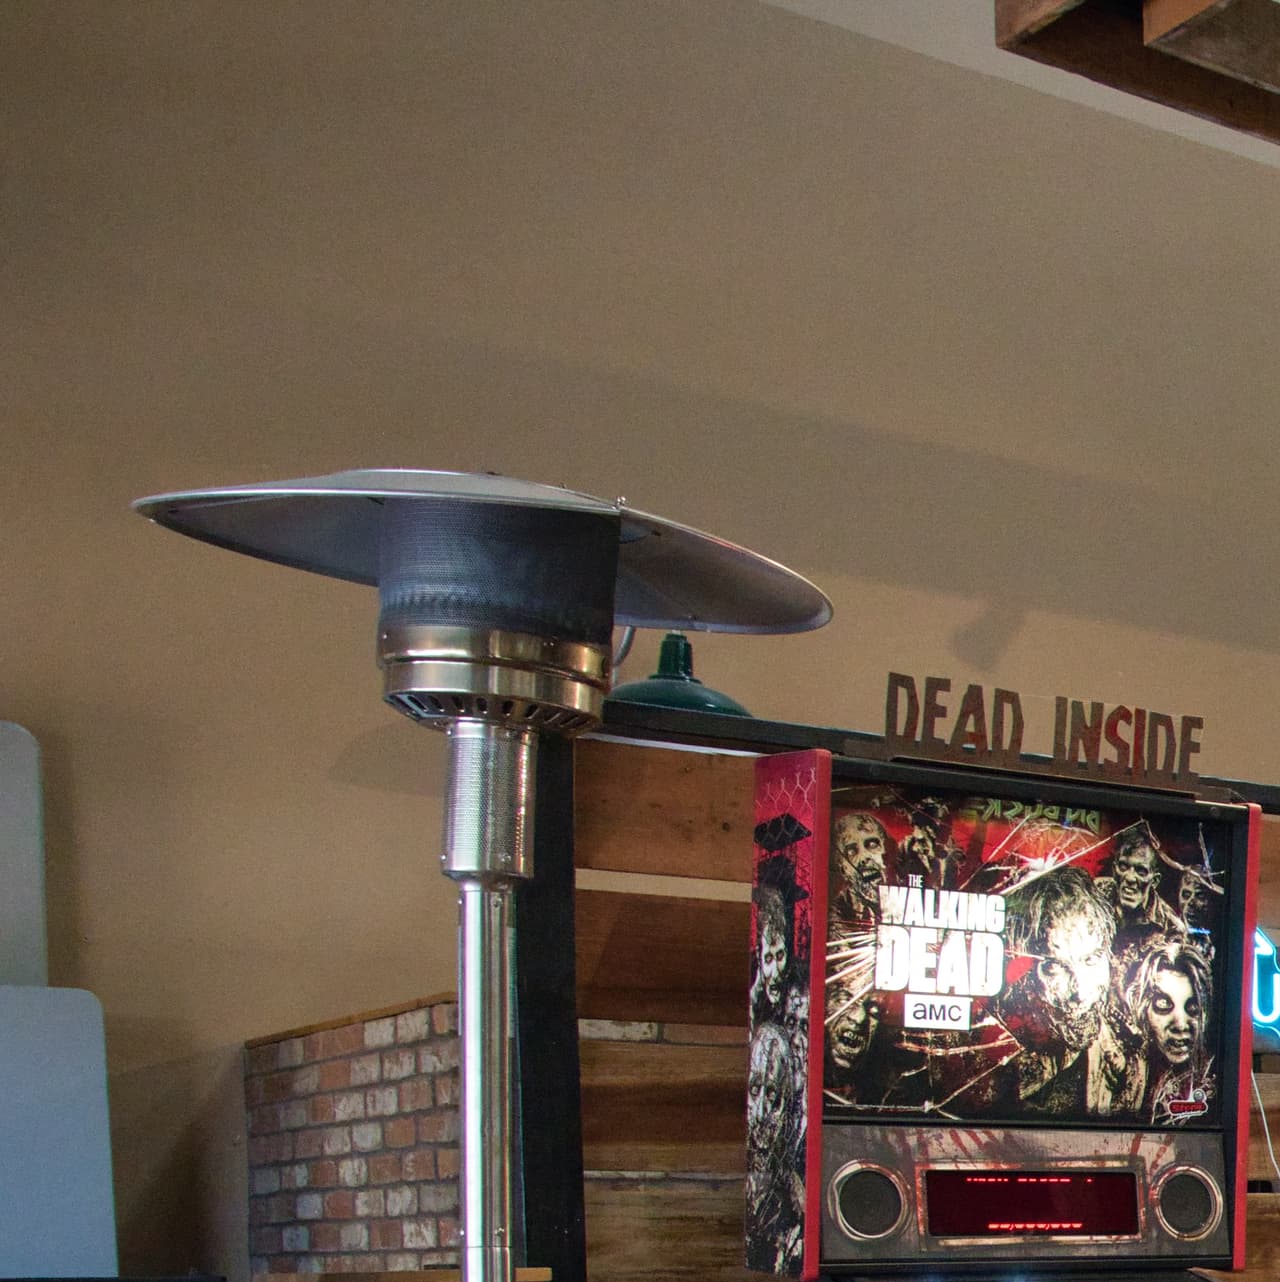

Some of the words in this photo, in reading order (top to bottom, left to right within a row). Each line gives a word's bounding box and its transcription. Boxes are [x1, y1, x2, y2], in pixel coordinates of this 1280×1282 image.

[885, 671, 1025, 756] DEAD
[1053, 695, 1204, 780] INSIDE
[878, 884, 1006, 933] WALKING
[908, 873, 923, 888] THE
[874, 924, 1004, 997] DEAD
